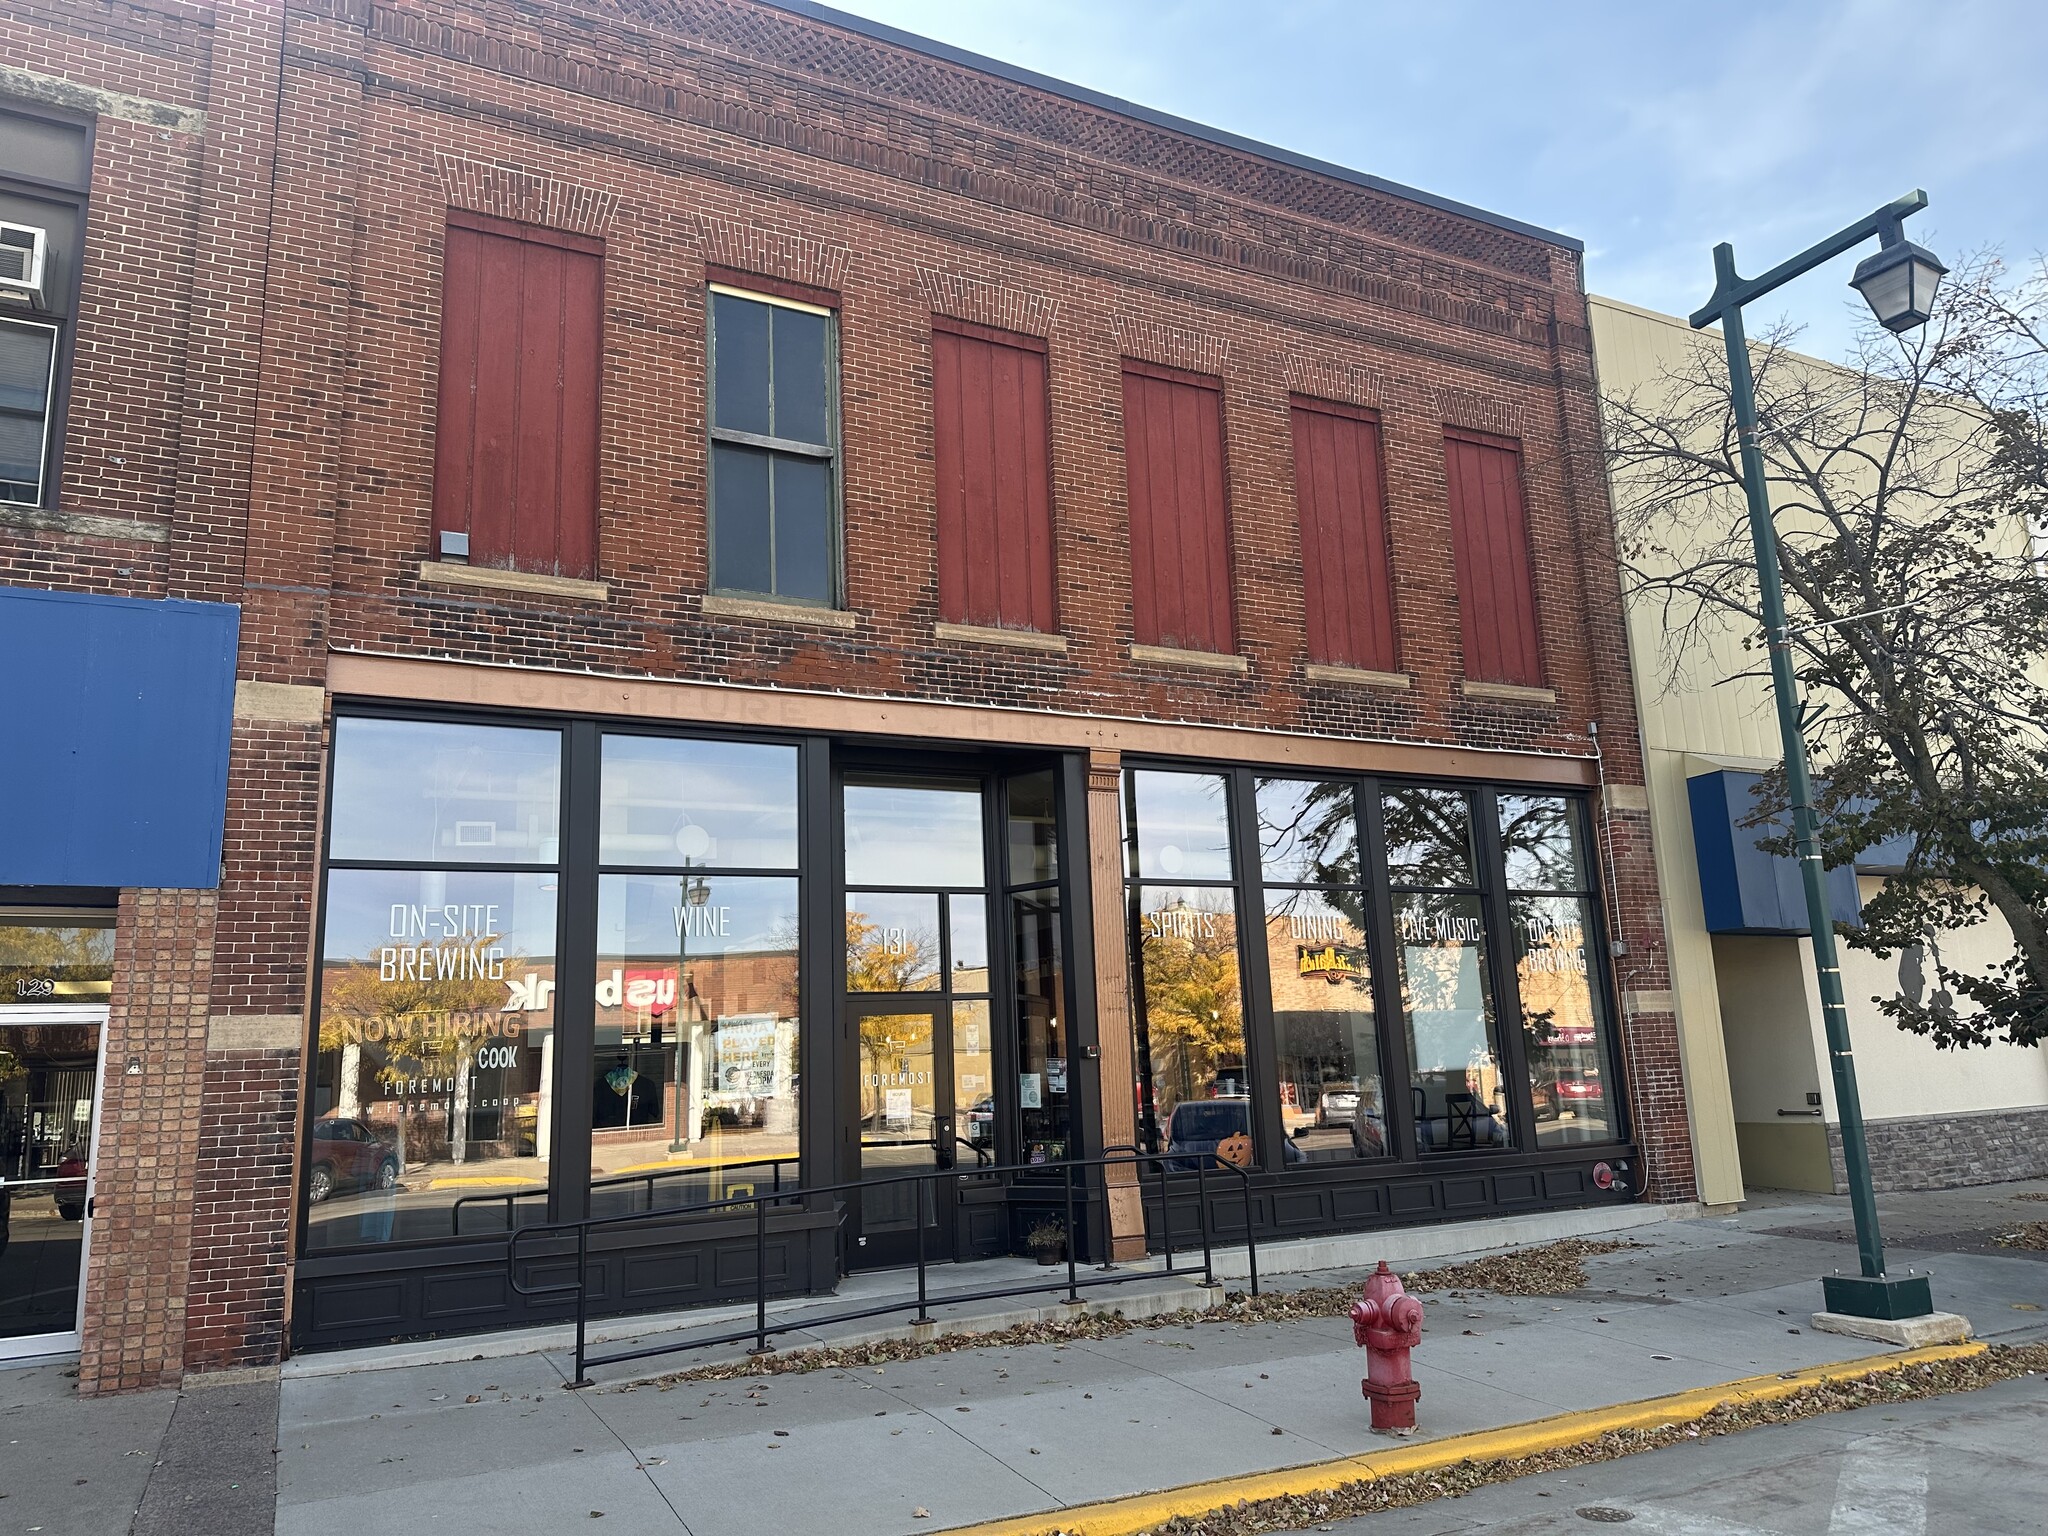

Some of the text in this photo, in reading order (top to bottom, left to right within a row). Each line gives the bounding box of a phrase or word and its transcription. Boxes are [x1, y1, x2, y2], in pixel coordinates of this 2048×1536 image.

[390, 904, 499, 937] ON-SITE
[672, 906, 731, 937] WINE
[1150, 911, 1215, 939] SPIRITS
[1290, 914, 1344, 940] DINING
[1401, 915, 1480, 942] LIVE MUSIC
[882, 927, 908, 955] 131
[379, 946, 505, 982] BREWING
[16, 978, 55, 996] 129
[341, 1012, 522, 1043] NOW HIRING
[722, 1035, 776, 1049] PLAYED
[478, 1045, 518, 1070] COOK
[722, 1051, 759, 1063] HERE
[752, 1060, 771, 1068] EVERY
[864, 1071, 932, 1087] FOREMOST
[350, 1097, 520, 1115] w.Foremost.coop
